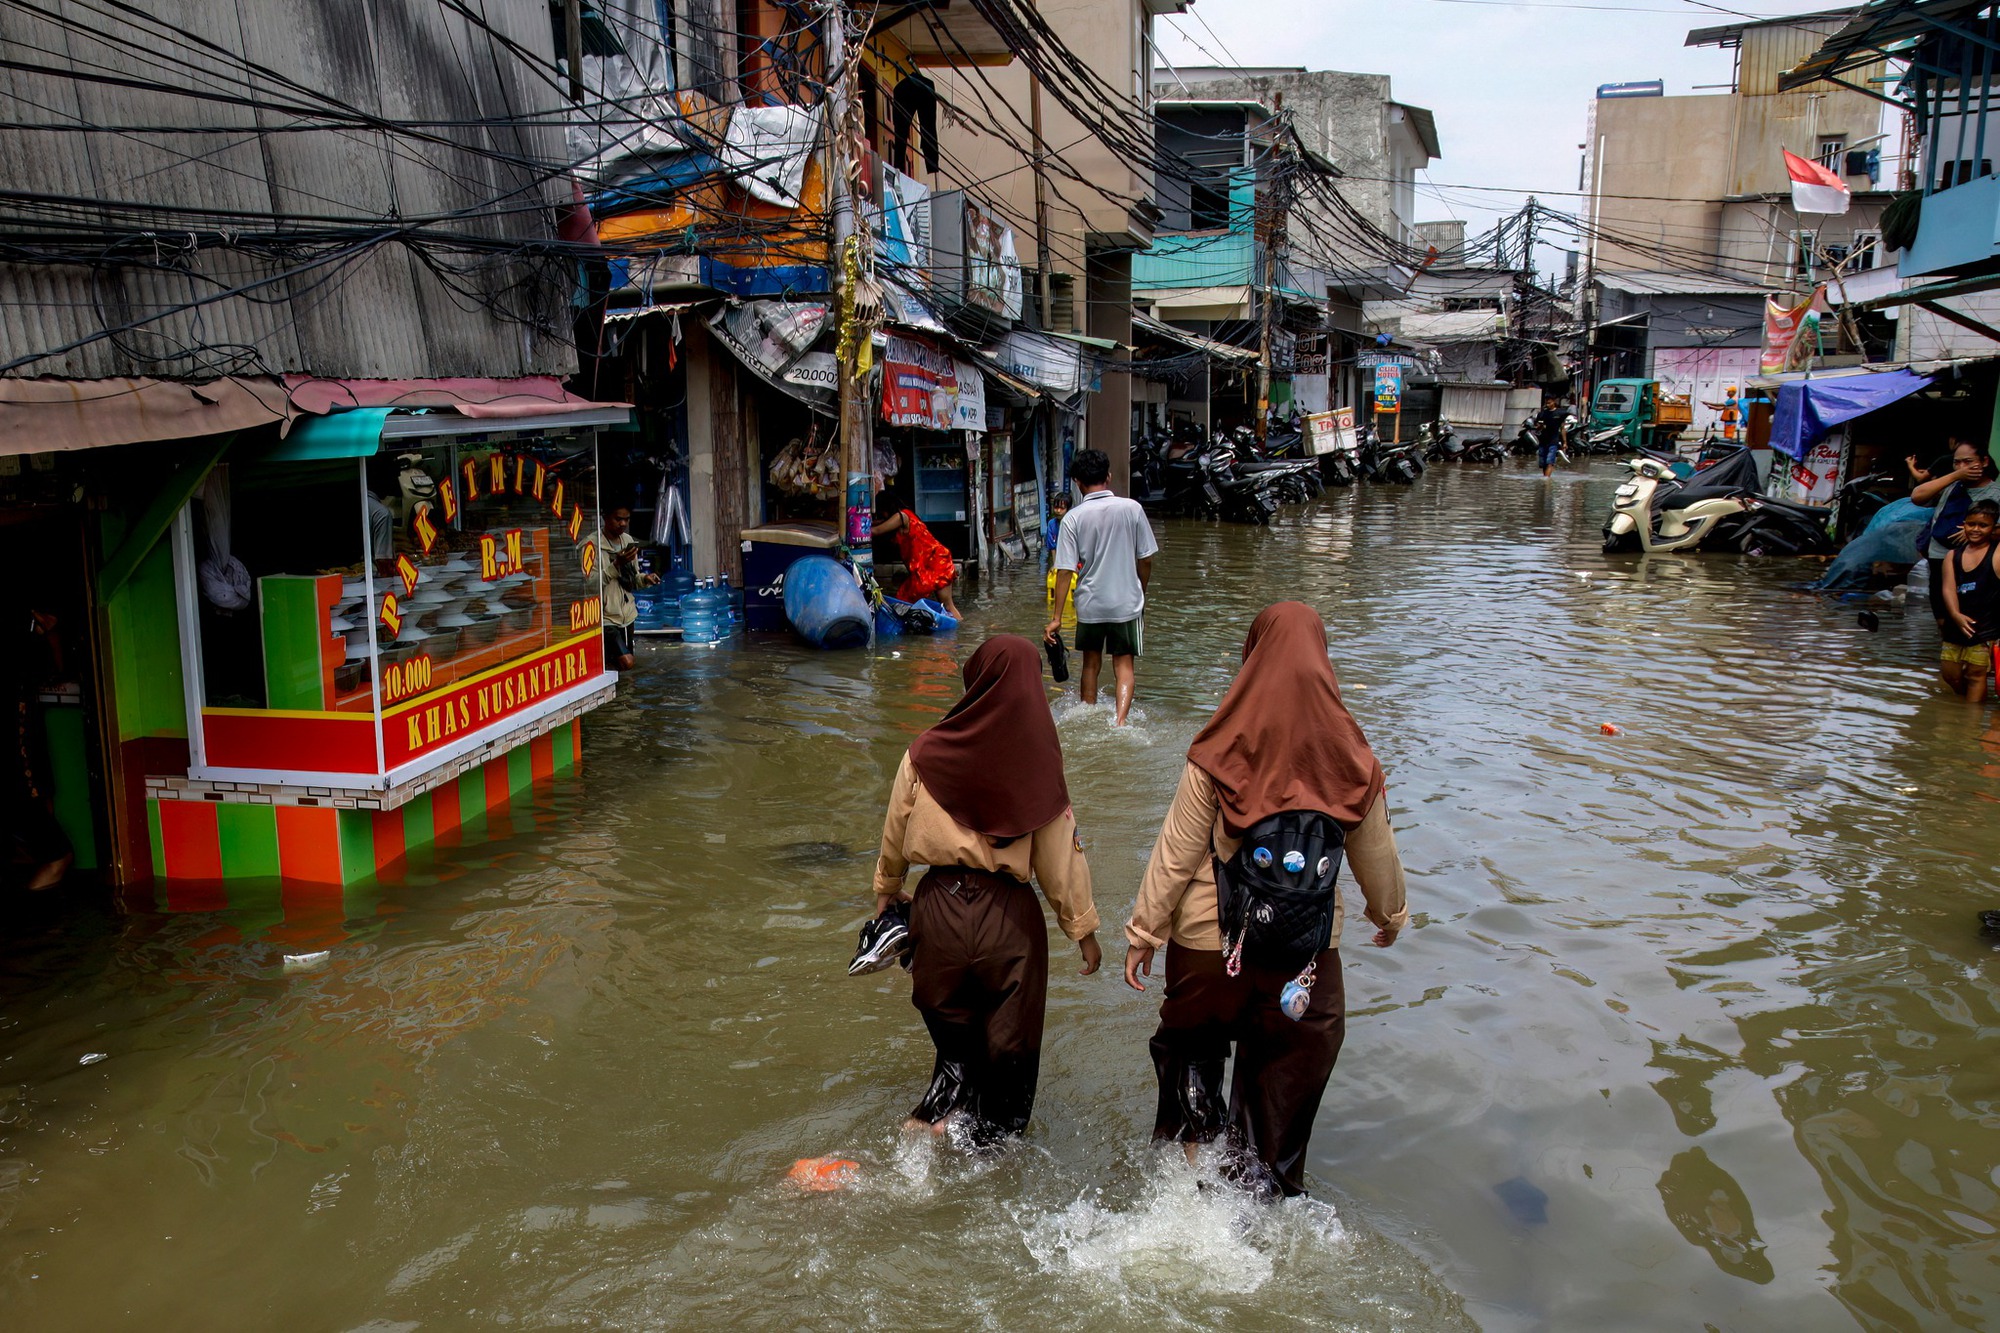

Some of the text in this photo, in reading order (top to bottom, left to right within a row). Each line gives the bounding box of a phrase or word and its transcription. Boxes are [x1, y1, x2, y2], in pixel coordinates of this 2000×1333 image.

[570, 597, 600, 633] 12.000
[406, 648, 588, 751] KHAS NUSANTARA
